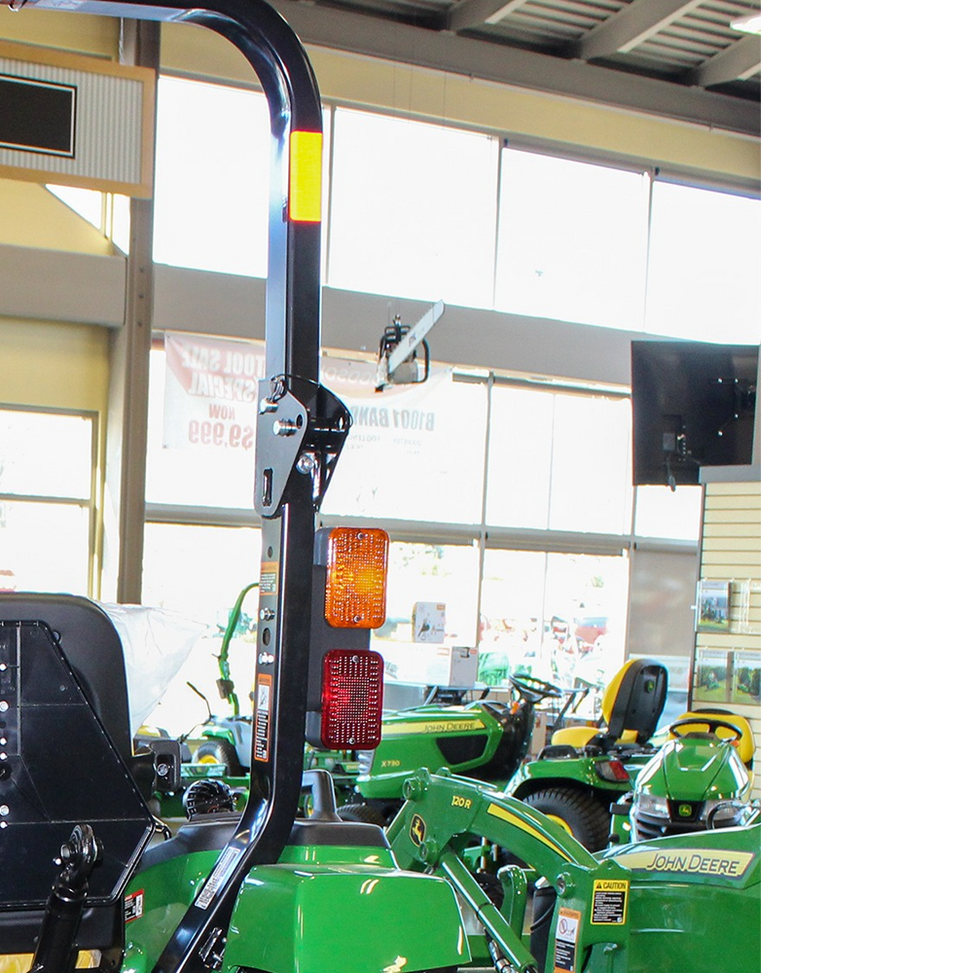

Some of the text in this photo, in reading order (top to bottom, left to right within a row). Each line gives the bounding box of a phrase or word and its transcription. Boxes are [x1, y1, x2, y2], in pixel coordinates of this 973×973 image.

[424, 721, 476, 733] JOHN DEERE
[647, 853, 740, 875] JOHN DEERE
[603, 882, 626, 890] CAUTION
